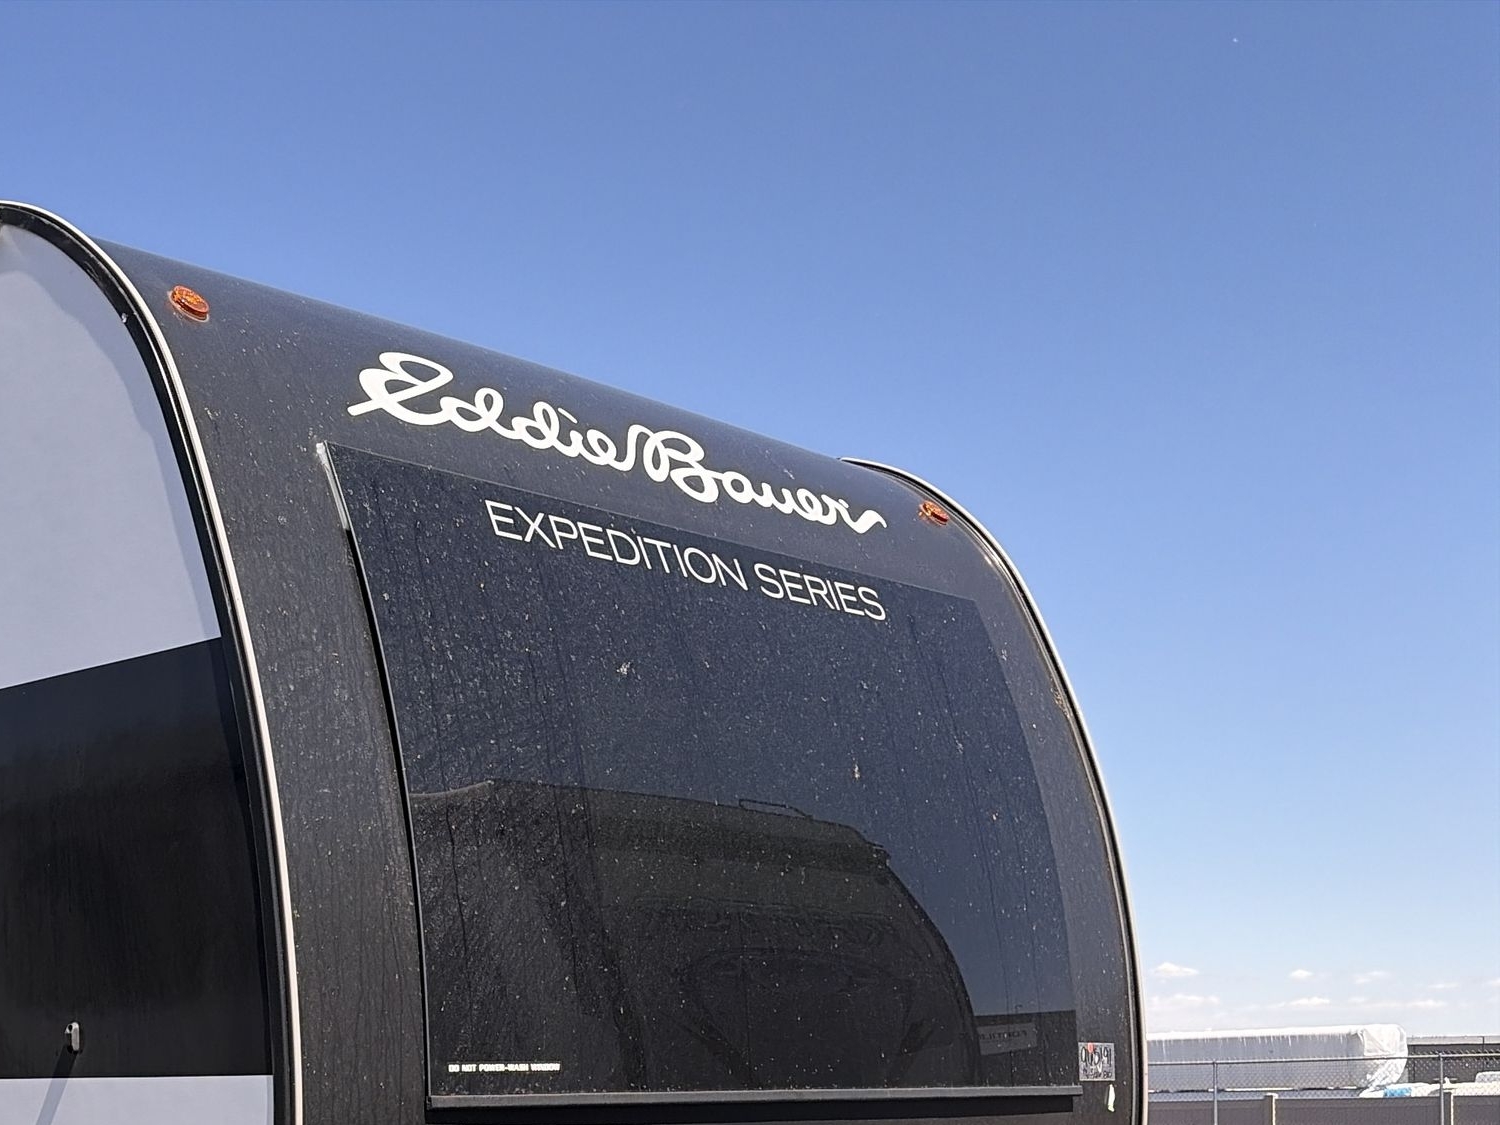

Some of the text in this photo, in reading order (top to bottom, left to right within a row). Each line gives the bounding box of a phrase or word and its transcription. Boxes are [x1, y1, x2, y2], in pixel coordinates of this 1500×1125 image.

[347, 351, 887, 534] Eddie Bauer
[484, 499, 887, 622] EXPEDITION SERIES
[448, 1063, 561, 1073] DO NOT POWER-WASH WINDOW
